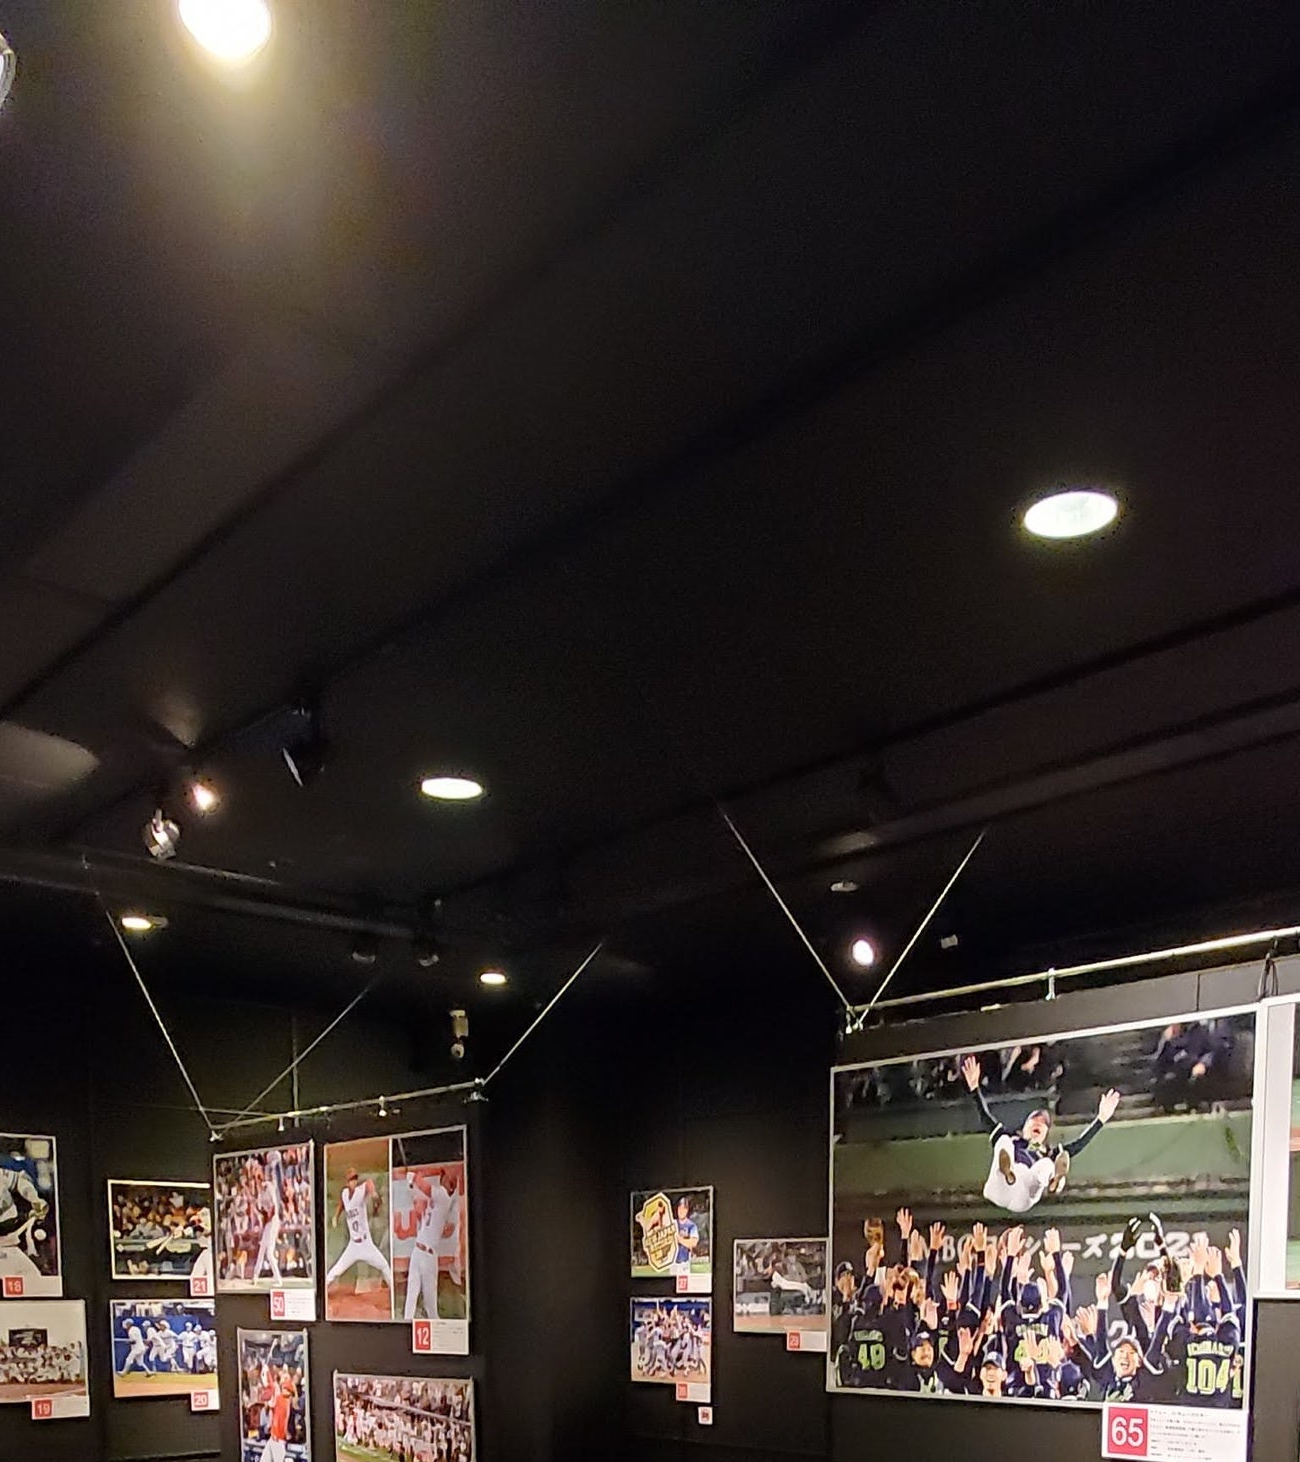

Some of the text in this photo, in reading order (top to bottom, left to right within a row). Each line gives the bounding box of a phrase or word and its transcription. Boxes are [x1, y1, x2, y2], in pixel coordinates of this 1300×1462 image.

[193, 1278, 207, 1293] 21
[416, 1326, 430, 1346] 12
[1185, 1356, 1231, 1396] 104
[193, 1393, 208, 1407] 20
[36, 1402, 52, 1416] 19
[1110, 1416, 1145, 1448] 65
